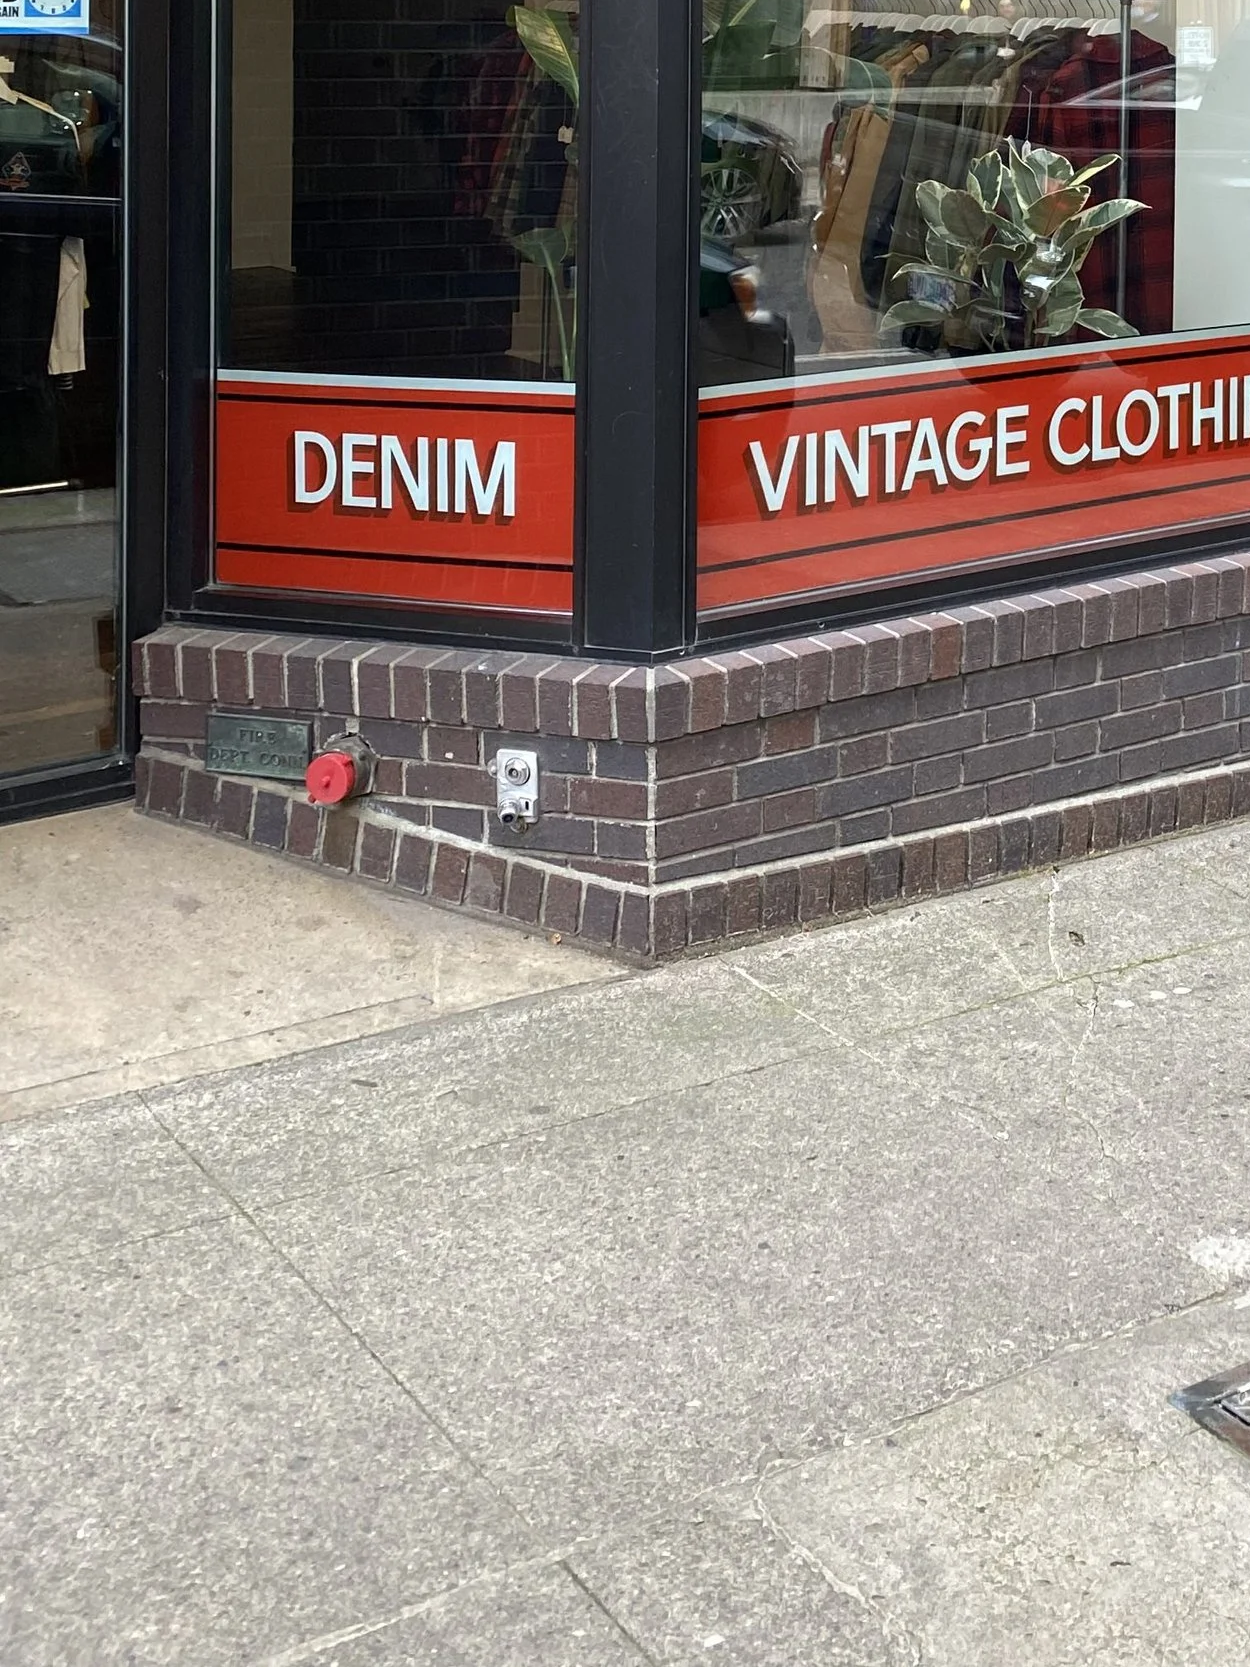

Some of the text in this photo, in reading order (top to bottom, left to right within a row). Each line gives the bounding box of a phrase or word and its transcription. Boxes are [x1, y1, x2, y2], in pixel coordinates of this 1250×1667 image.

[293, 430, 516, 517] DENIM
[748, 405, 1031, 512] VINTAGE
[239, 728, 277, 745] FIRE
